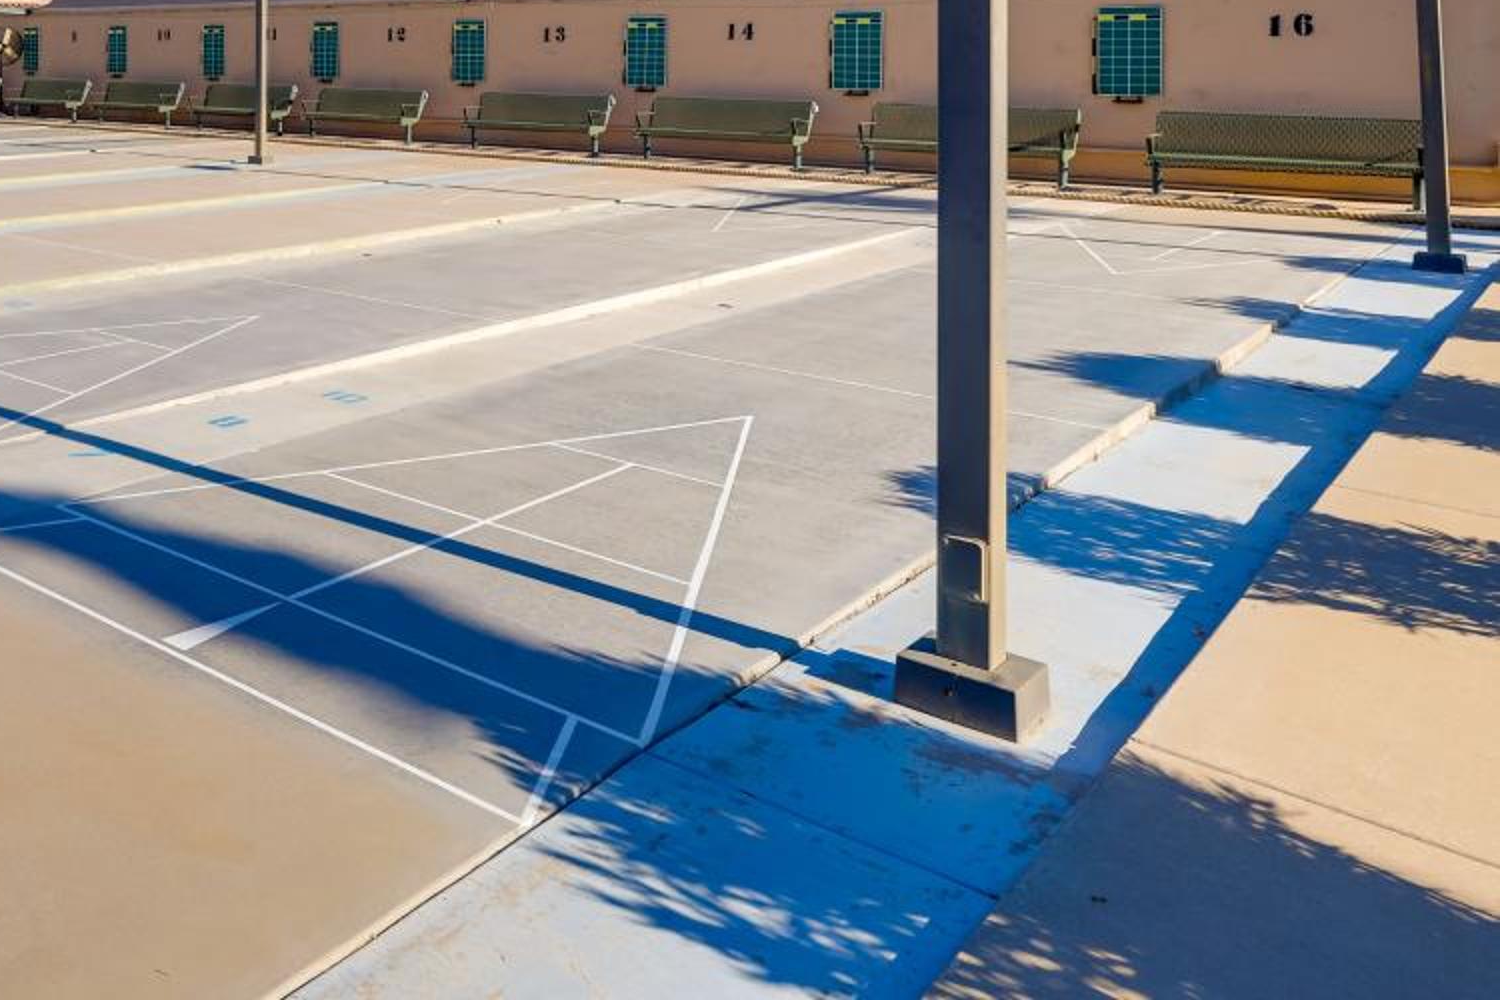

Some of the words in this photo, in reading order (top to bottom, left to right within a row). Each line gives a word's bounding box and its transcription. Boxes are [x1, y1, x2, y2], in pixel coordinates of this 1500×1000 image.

[726, 22, 754, 41] 14
[1267, 13, 1314, 37] 16
[387, 27, 406, 42] 12
[542, 26, 566, 43] 13
